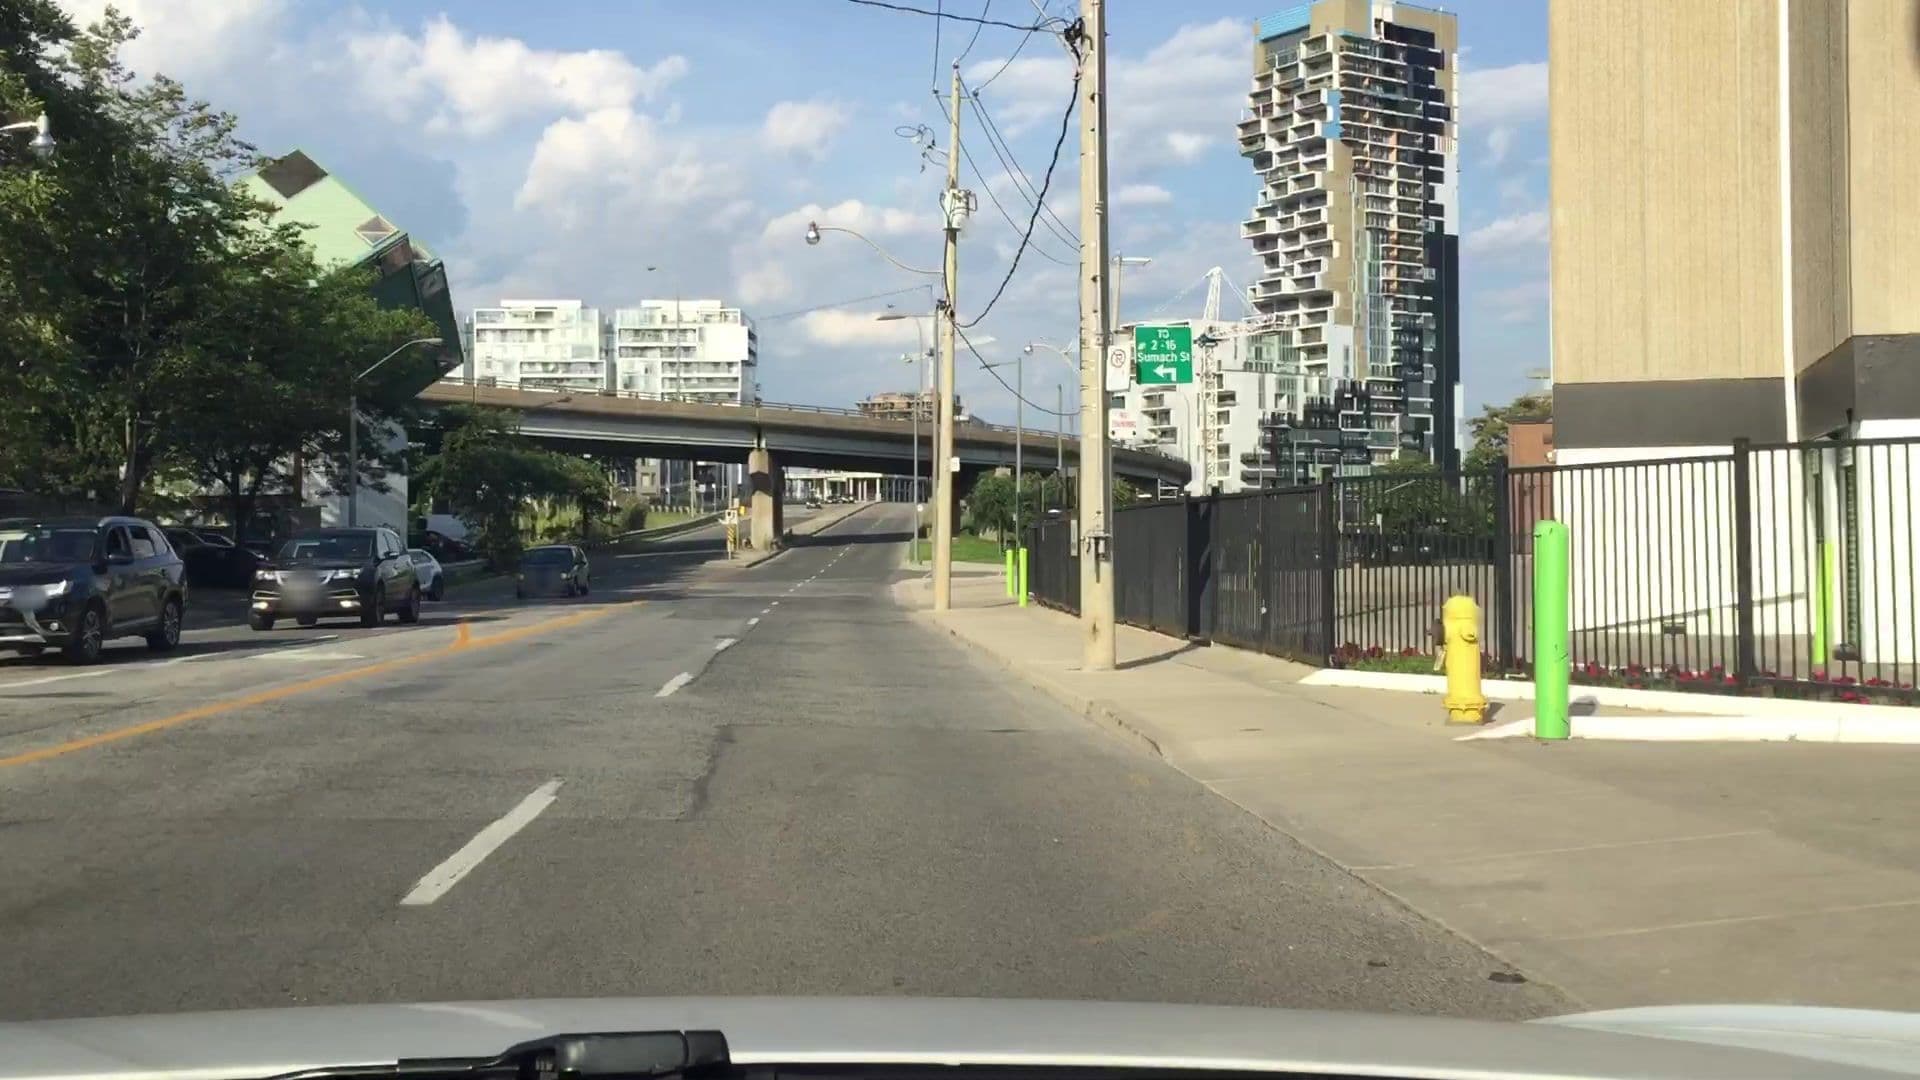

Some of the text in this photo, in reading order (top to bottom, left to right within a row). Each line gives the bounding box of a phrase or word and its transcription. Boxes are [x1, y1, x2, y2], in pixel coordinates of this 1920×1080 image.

[1157, 329, 1170, 339] TO
[1137, 351, 1190, 362] Sumach St
